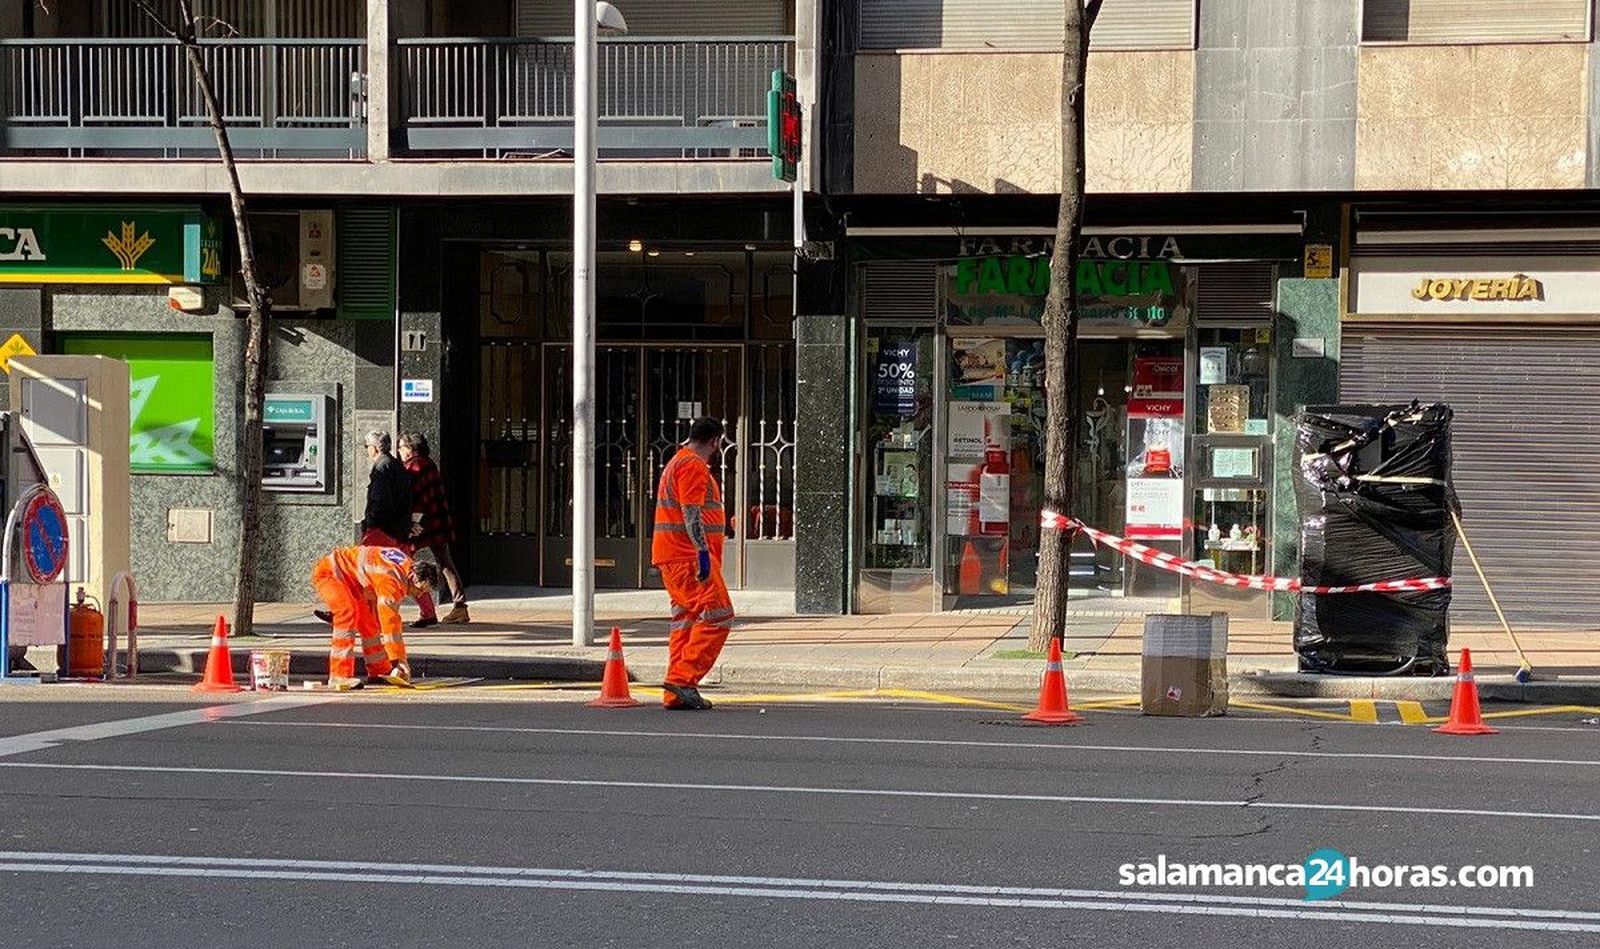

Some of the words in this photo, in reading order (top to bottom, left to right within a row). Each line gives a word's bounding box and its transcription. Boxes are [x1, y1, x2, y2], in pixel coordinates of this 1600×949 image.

[1411, 273, 1541, 301] JOYERÍA
[883, 349, 910, 357] VICHY
[878, 362, 915, 379] 50%
[1146, 404, 1172, 412] VICHY
